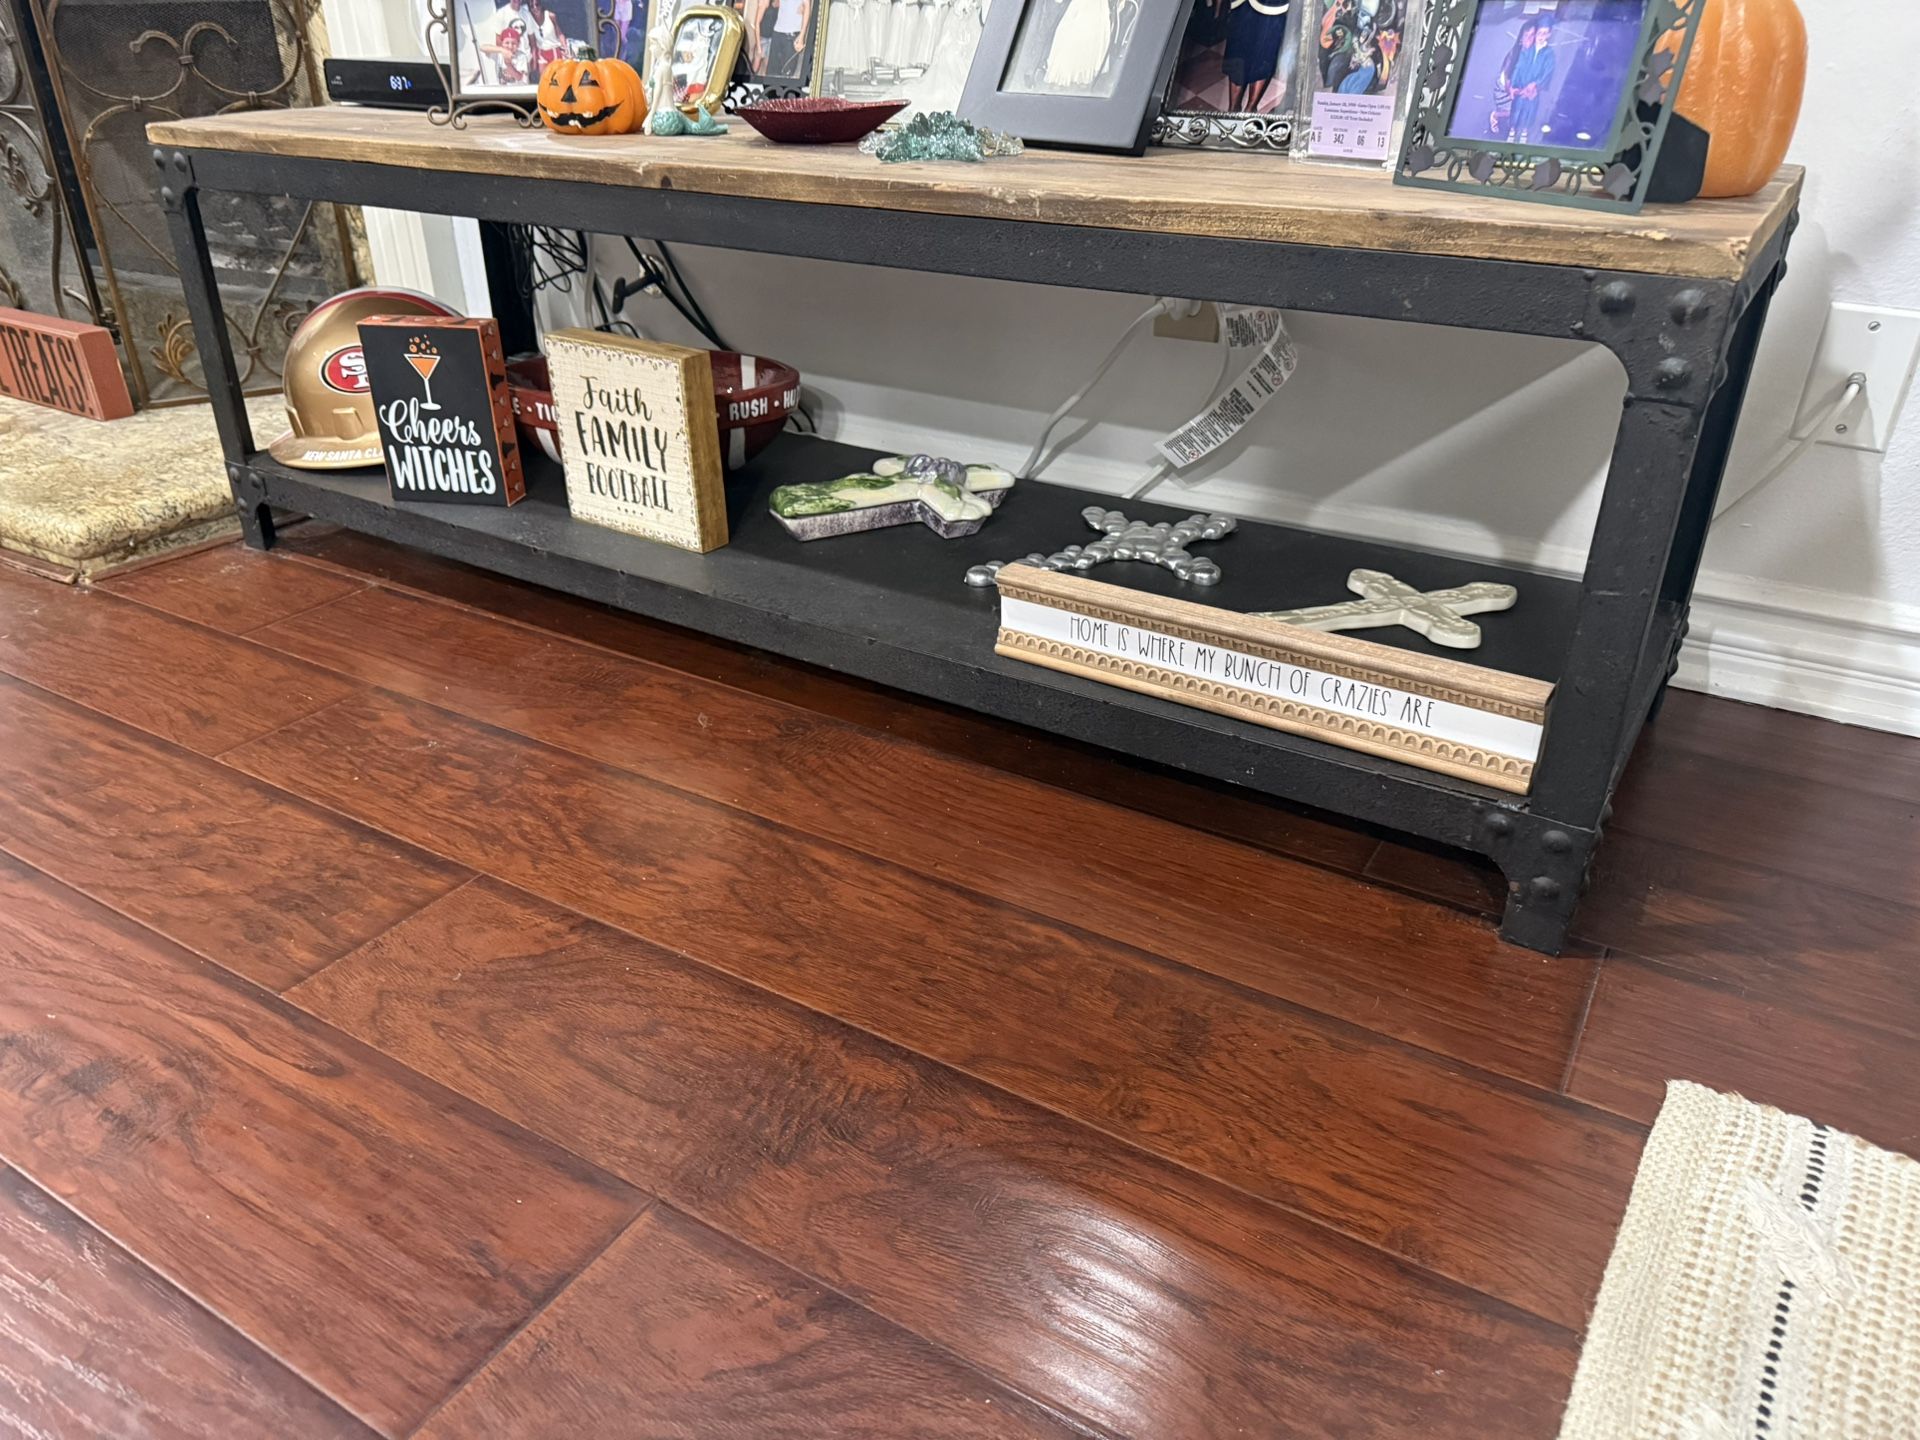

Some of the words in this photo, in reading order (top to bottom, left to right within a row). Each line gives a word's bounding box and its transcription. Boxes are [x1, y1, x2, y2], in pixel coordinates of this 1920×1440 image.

[379, 397, 481, 446] Cheers
[580, 376, 652, 422] Faith
[729, 396, 768, 421] RUSH
[324, 450, 362, 461] SANTA
[364, 447, 385, 459] CL
[575, 411, 668, 474] FAMILY
[389, 445, 496, 495] WITCHES
[586, 462, 673, 513] FOOTBALL
[1070, 616, 1109, 648] HOME
[1117, 627, 1129, 651] IS
[1138, 631, 1186, 667] WHERE
[1194, 647, 1216, 674] MY
[1225, 653, 1281, 690] BUNCH
[1290, 669, 1311, 697] OF
[1321, 677, 1392, 716] CRAZIES
[1400, 696, 1435, 728] ARE
